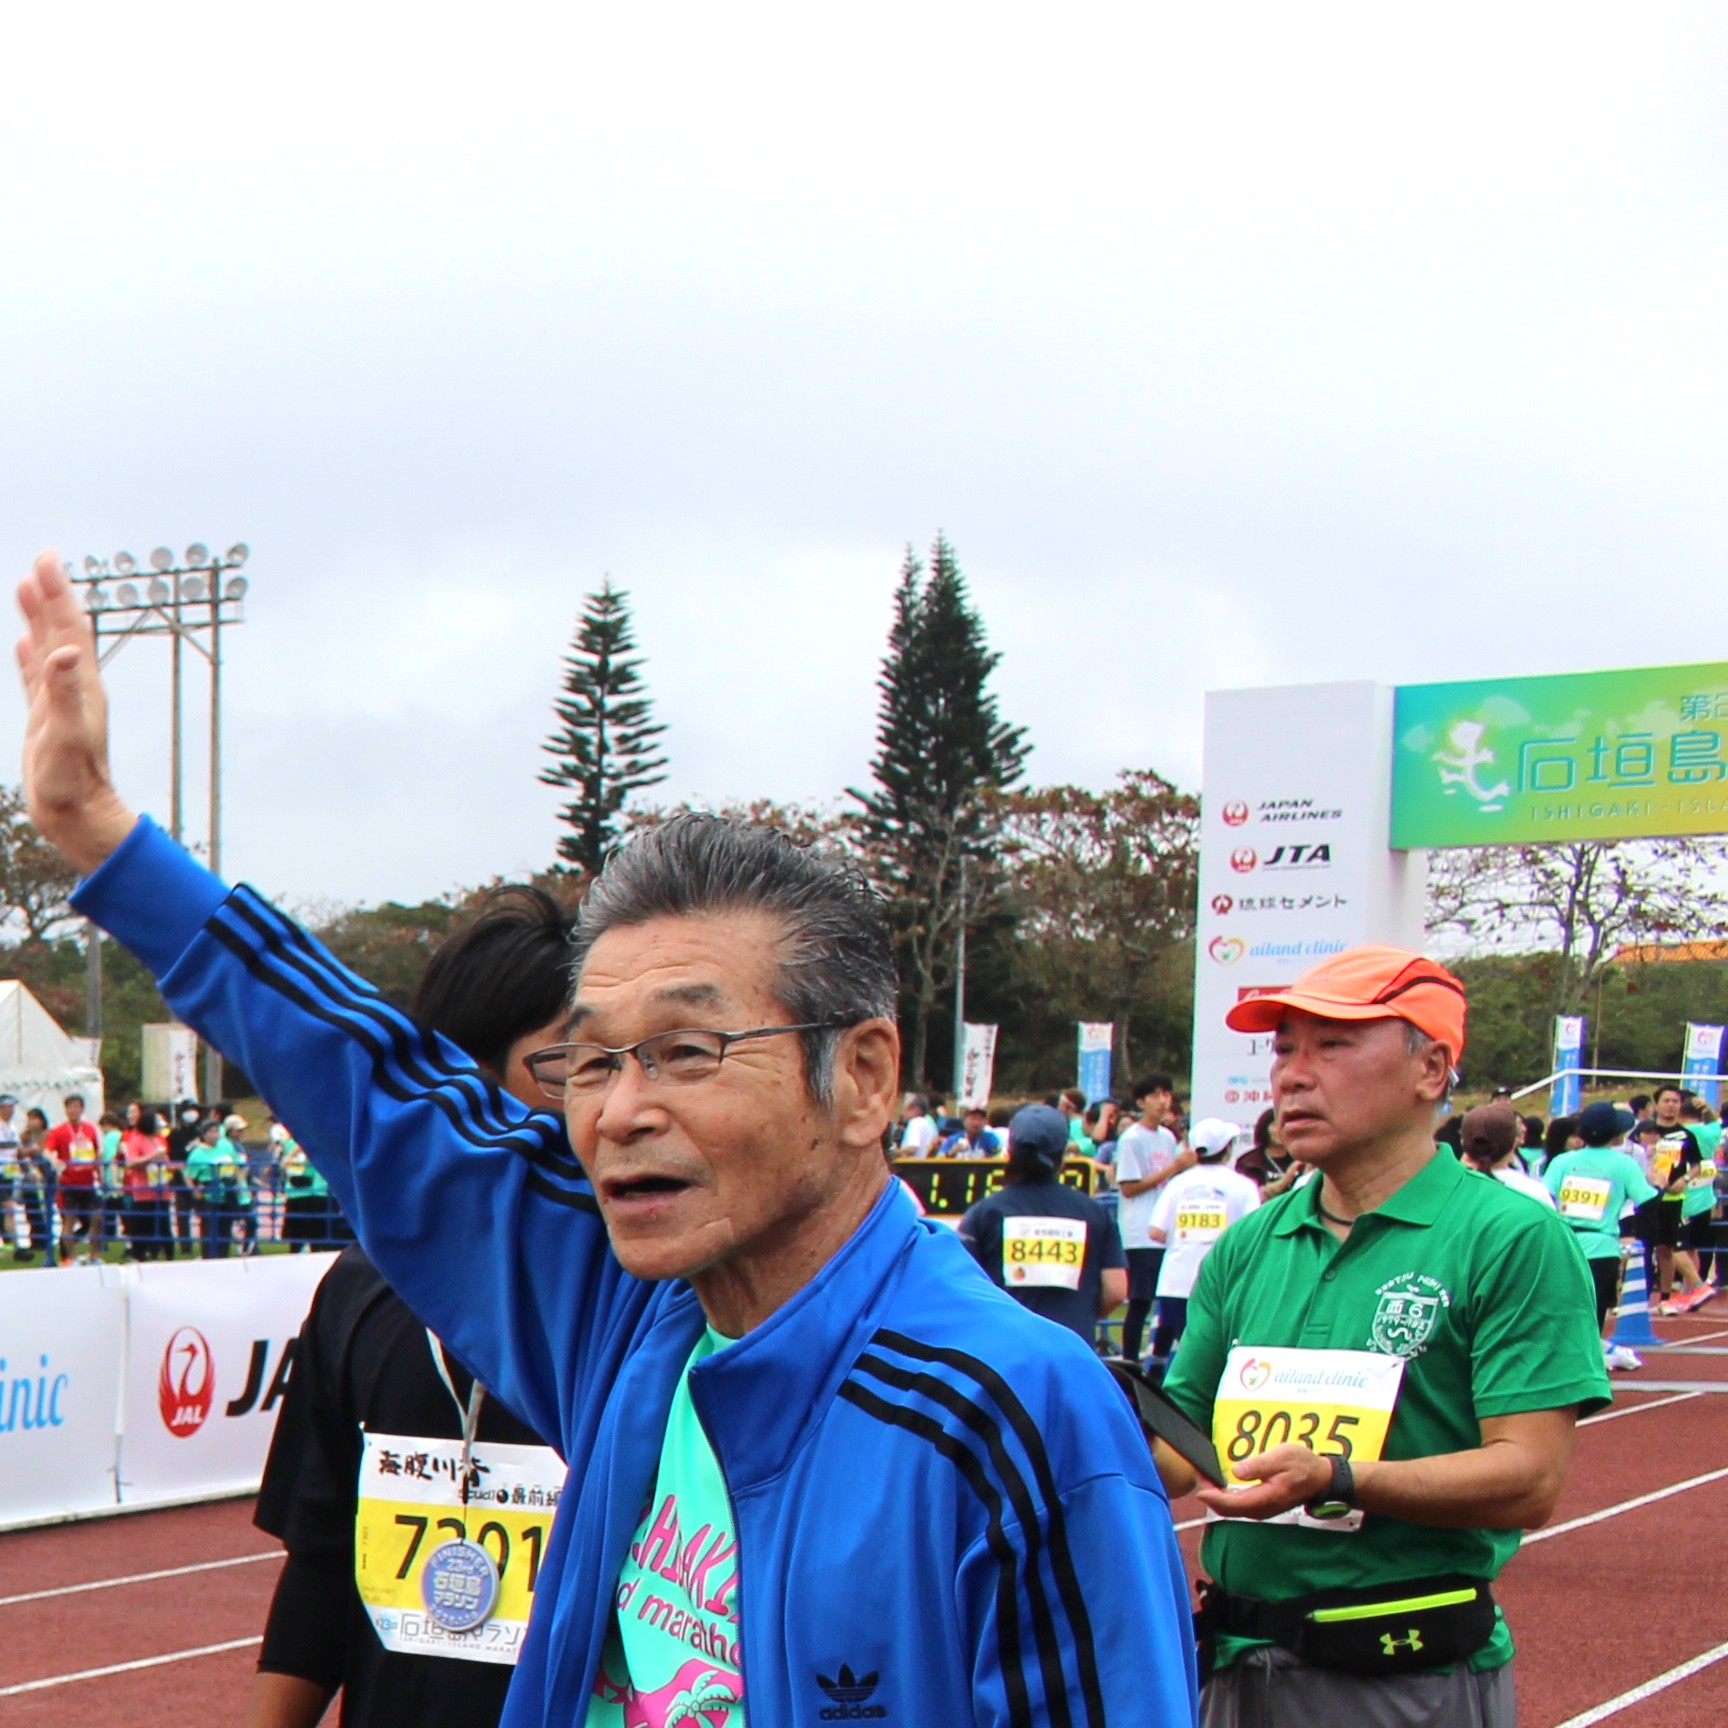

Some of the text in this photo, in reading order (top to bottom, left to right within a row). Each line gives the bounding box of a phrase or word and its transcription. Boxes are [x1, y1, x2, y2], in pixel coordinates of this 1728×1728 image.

[1517, 731, 1728, 793] 石垣島
[1258, 799, 1314, 811] JAPAN
[1531, 801, 1651, 822] ISHIGAKI
[1261, 809, 1342, 823] AIRLINES
[1263, 844, 1331, 865] JTA
[1561, 1188, 1601, 1206] 9391
[1178, 1213, 1221, 1228] 9183
[1011, 1239, 1078, 1264] 8443
[1274, 1368, 1370, 1388] ailand clinic
[170, 1406, 204, 1427] JAL
[1228, 1410, 1360, 1462] 8035
[819, 1702, 887, 1721] adidas
